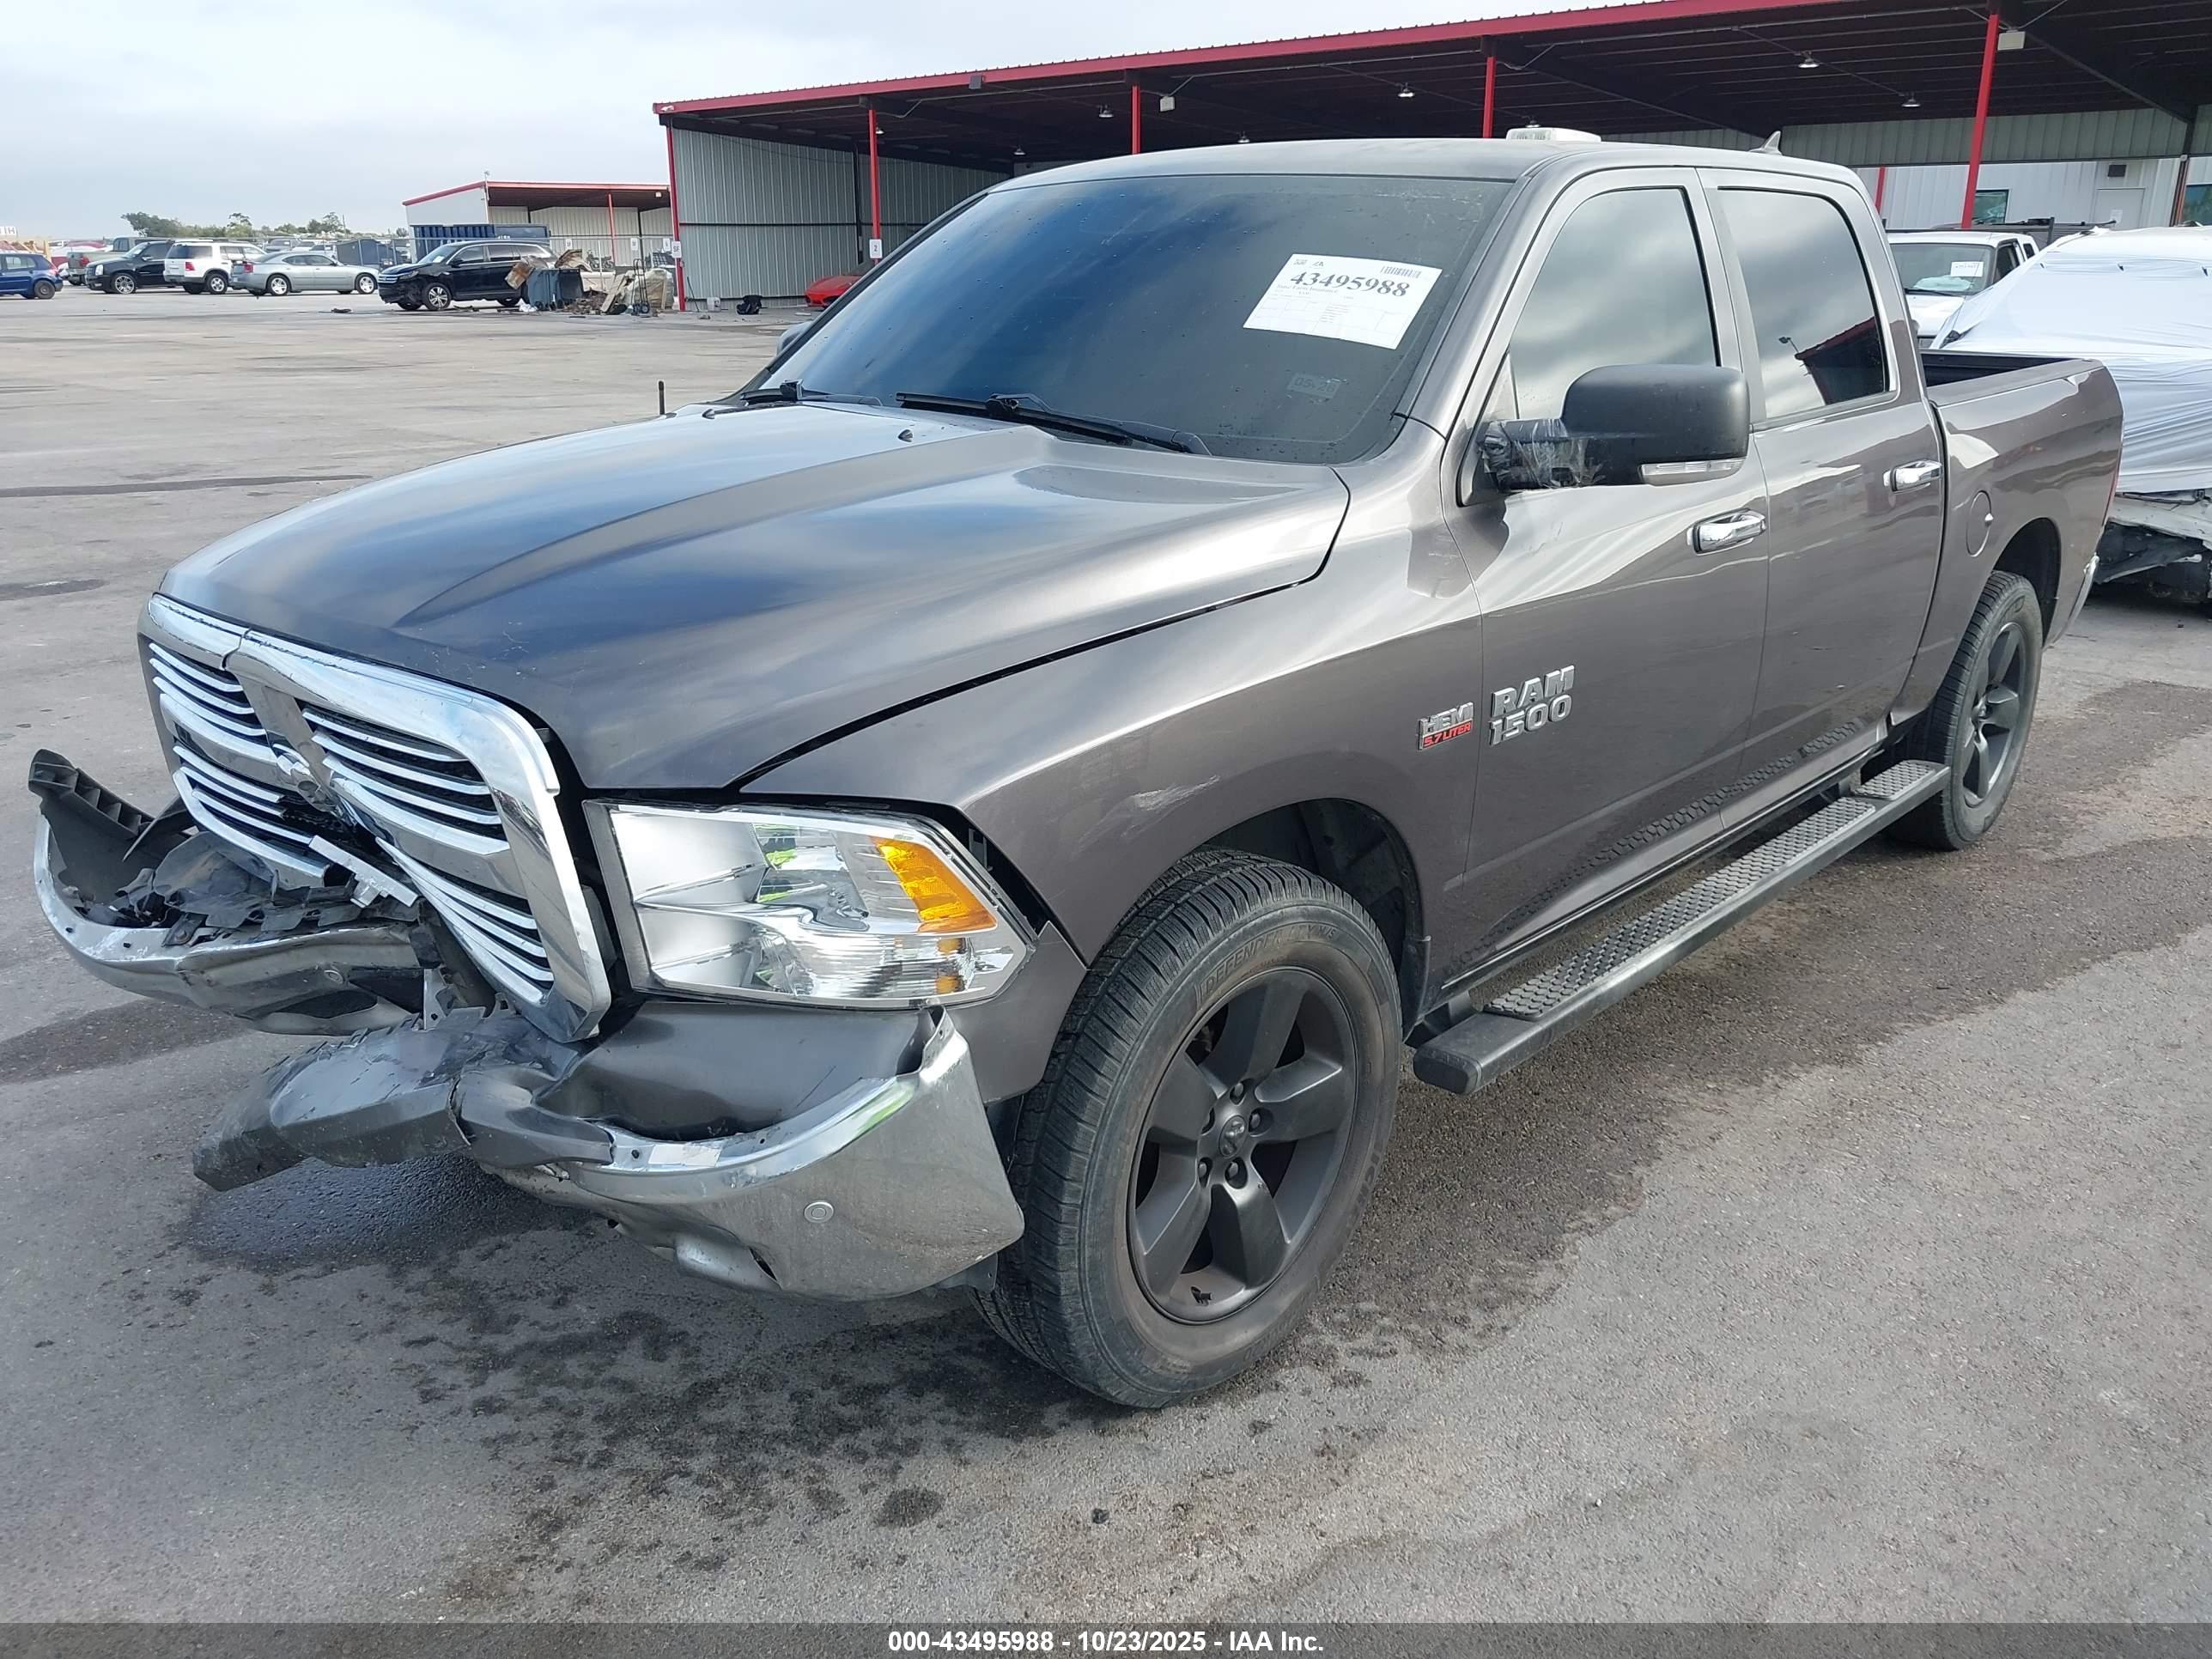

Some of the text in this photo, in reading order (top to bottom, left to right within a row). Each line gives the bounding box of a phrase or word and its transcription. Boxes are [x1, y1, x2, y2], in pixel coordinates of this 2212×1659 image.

[1290, 271, 1411, 297] 43495988
[1491, 665, 1575, 718] RAM
[1443, 722, 1471, 741] LITER
[1489, 694, 1573, 746] 1500
